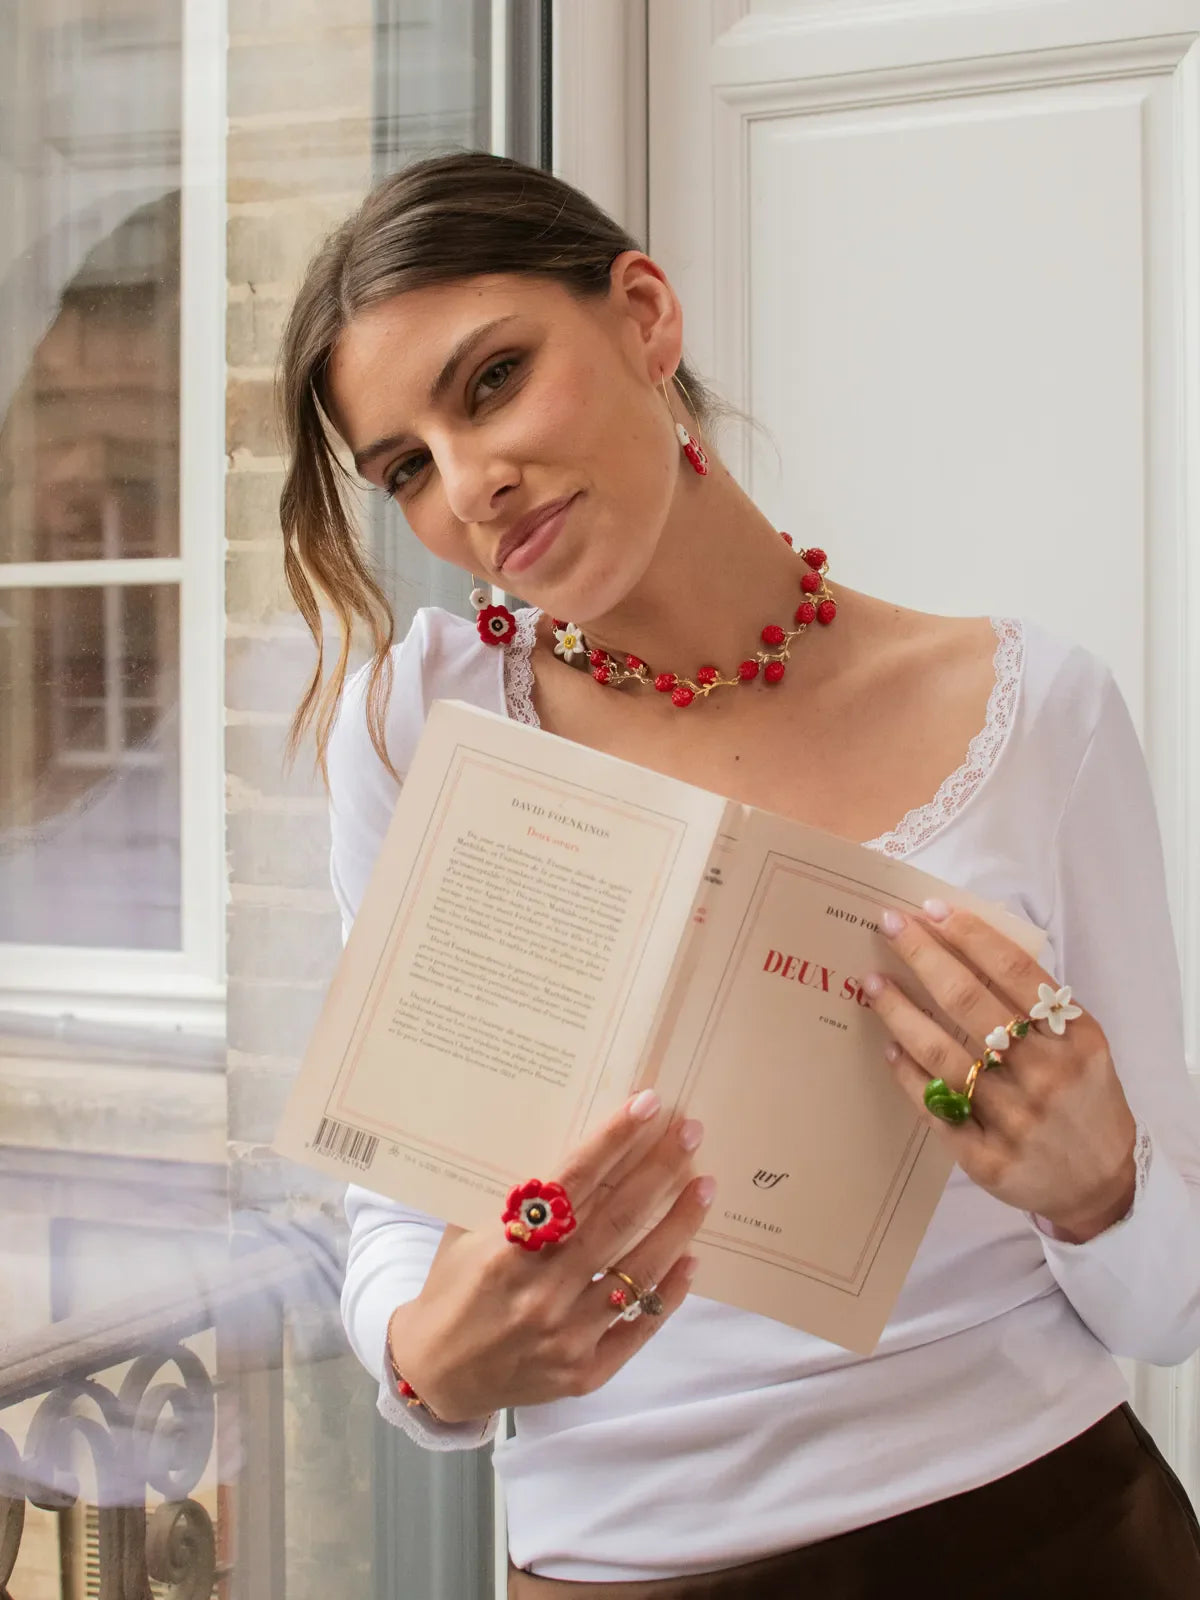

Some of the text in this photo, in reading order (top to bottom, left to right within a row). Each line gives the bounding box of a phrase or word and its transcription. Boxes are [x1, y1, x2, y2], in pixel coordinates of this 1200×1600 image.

[511, 797, 611, 839] DAVID FOENKINOS
[826, 905, 857, 925] DAVID
[763, 950, 836, 992] DEUX
[818, 1014, 849, 1031] roman
[752, 1168, 790, 1190] nrf
[724, 1210, 783, 1234] GALLIMARD
